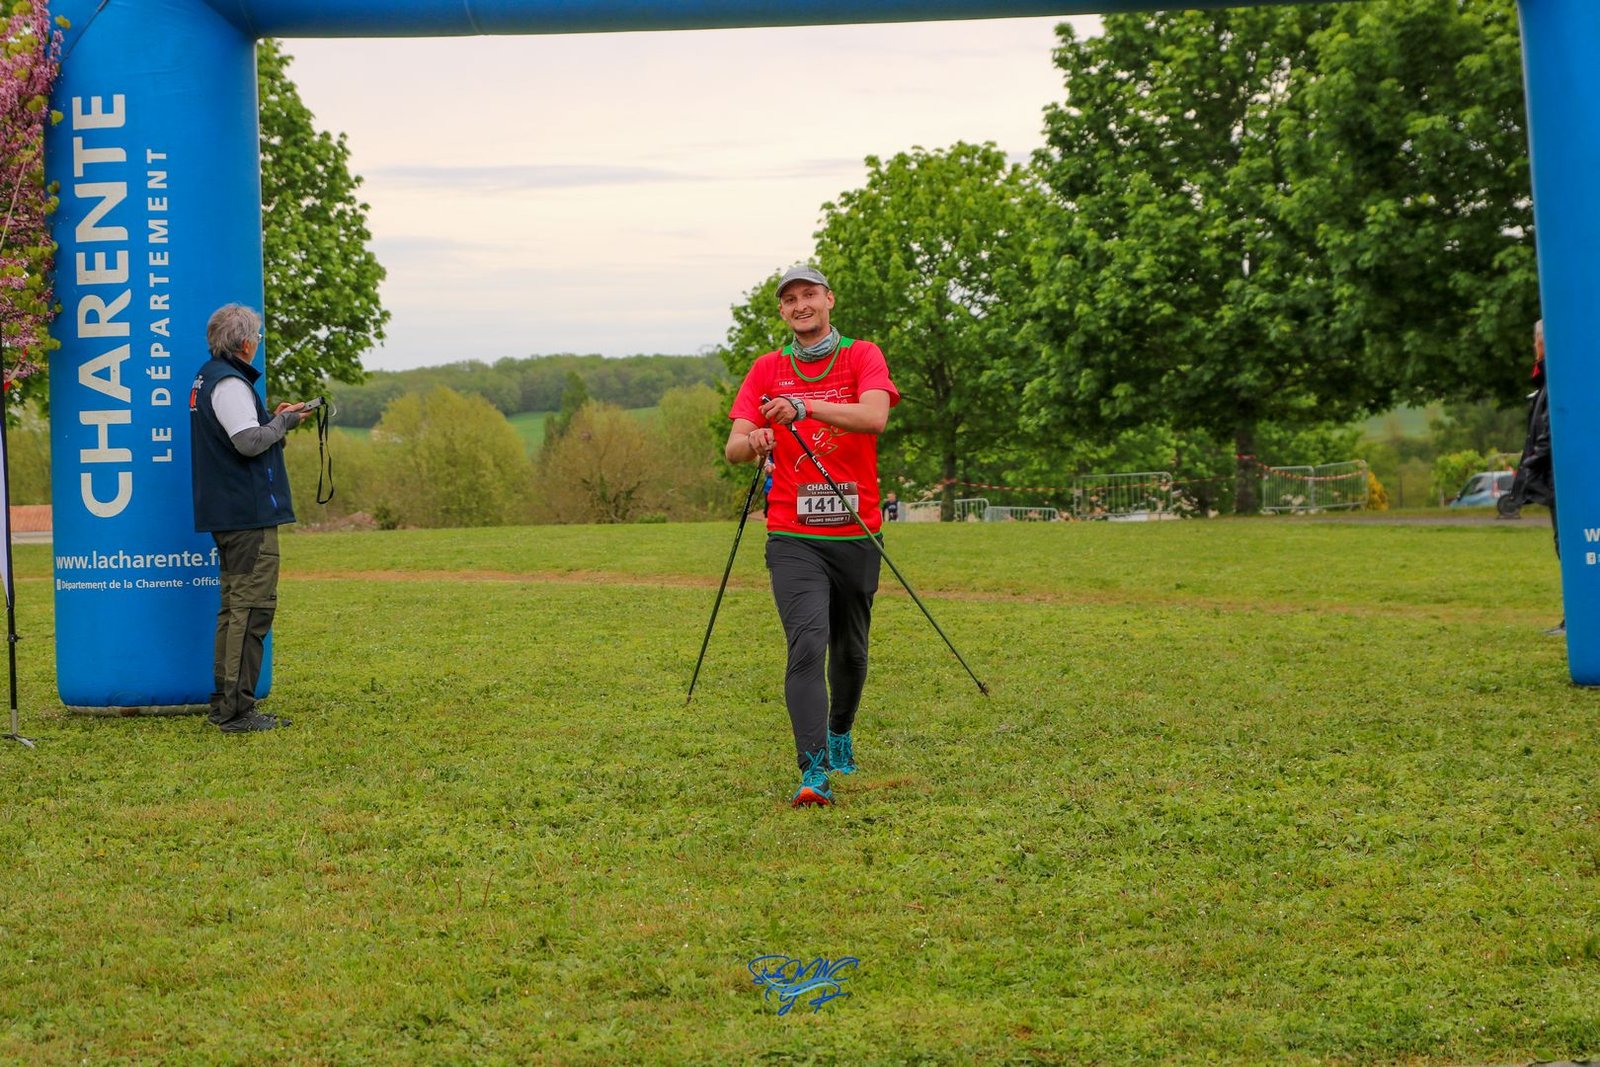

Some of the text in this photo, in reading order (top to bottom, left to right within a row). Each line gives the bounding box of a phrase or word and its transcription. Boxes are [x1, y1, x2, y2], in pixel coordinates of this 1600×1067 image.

[72, 93, 132, 518] CHARENTE
[146, 148, 172, 462] LE DÉPARTEMENT
[811, 455, 829, 477] LEKI
[109, 580, 121, 589] de
[124, 579, 133, 589] la
[136, 578, 183, 589] Charente
